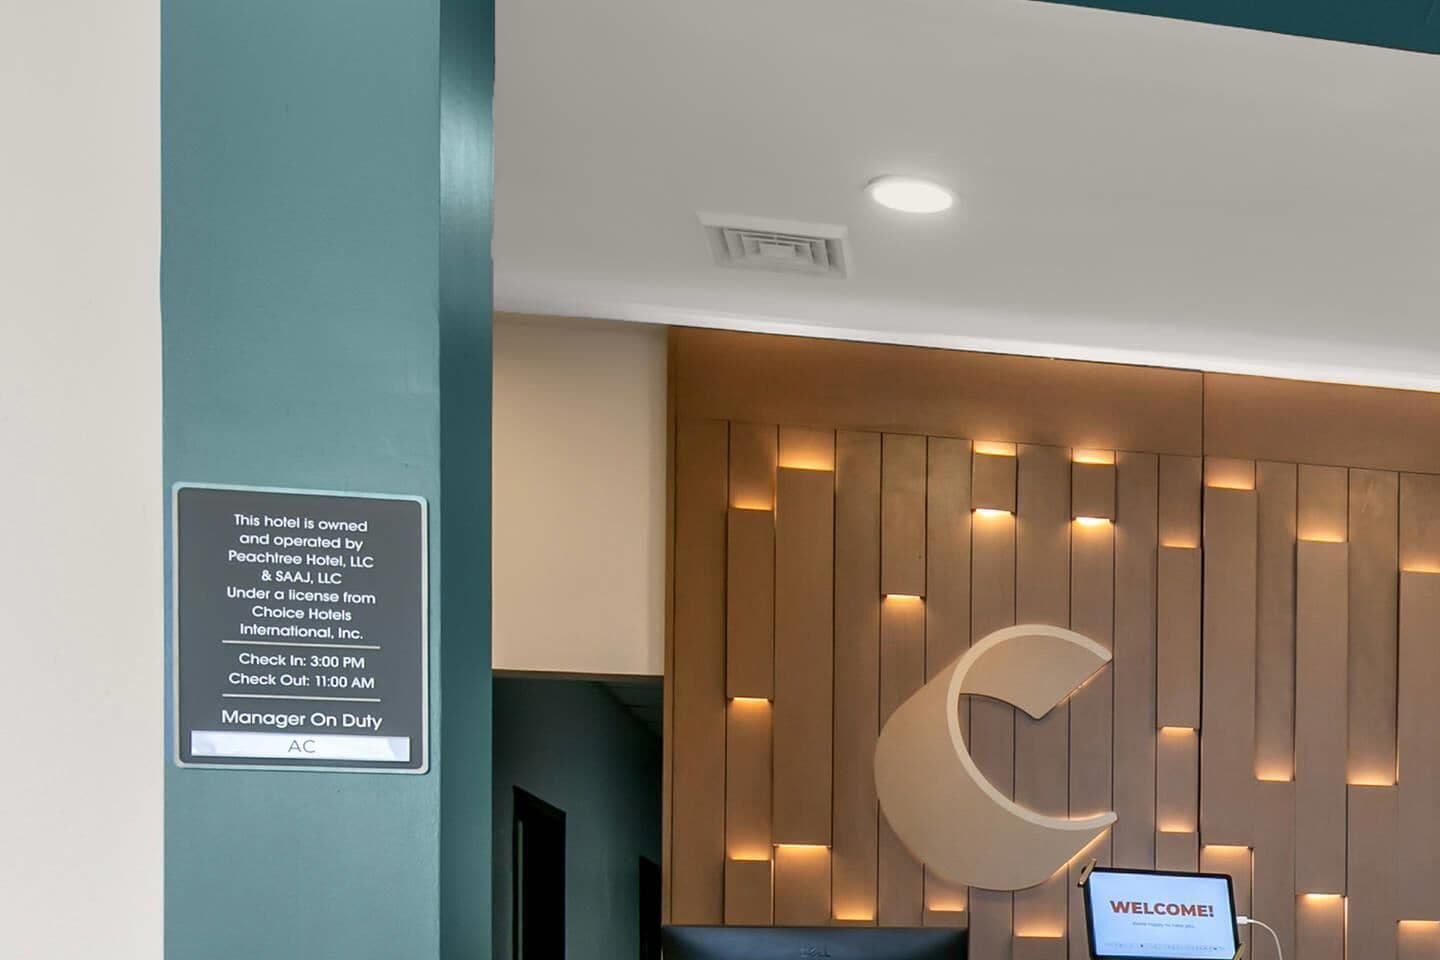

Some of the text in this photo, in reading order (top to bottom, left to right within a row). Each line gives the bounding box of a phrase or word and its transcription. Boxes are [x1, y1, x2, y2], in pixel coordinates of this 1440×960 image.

[234, 514, 368, 532] This hotel is owned
[240, 534, 363, 552] and operated by
[228, 550, 374, 568] Peachtree Hotel, LLC
[262, 570, 342, 584] & SAAJ, LLC
[227, 586, 376, 604] Under a license from
[252, 606, 352, 621] Choice Hotels
[240, 624, 363, 639] International, Inc.
[239, 653, 365, 668] Check In: 3:00 PM
[228, 672, 375, 688] Check Out: 11:00 AM
[222, 710, 382, 730] Manager On Duty
[288, 740, 316, 753] AC
[1110, 900, 1215, 917] WELCOME!
